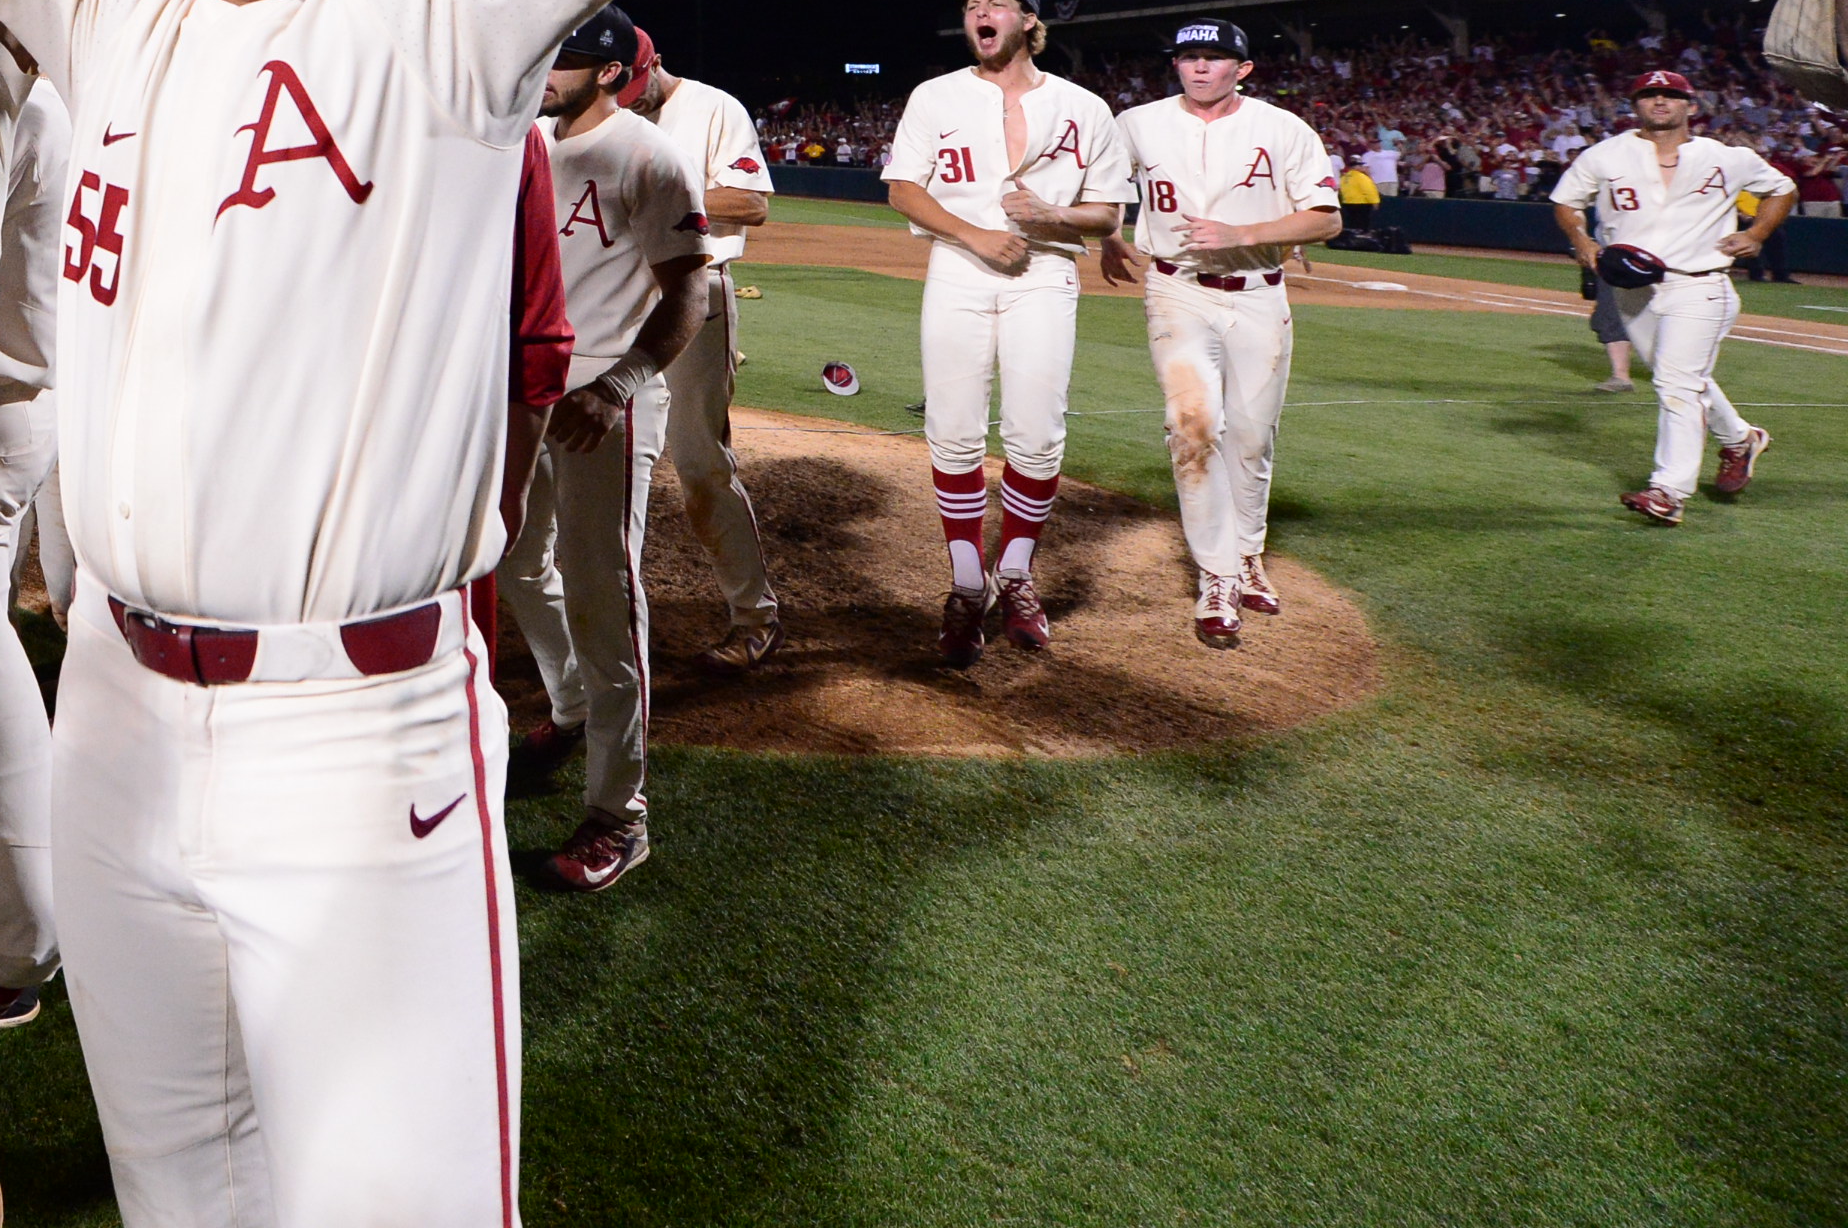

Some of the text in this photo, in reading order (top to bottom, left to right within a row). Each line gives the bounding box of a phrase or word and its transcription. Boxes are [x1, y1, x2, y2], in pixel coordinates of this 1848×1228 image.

[1645, 70, 1670, 86] A
[211, 59, 374, 236] A
[938, 146, 976, 184] 31
[1037, 119, 1087, 170] A
[1232, 147, 1276, 191] A
[1689, 166, 1729, 199] A
[558, 179, 615, 249] A
[1146, 179, 1179, 214] 18
[1609, 187, 1641, 212] 13
[63, 169, 130, 307] 55
